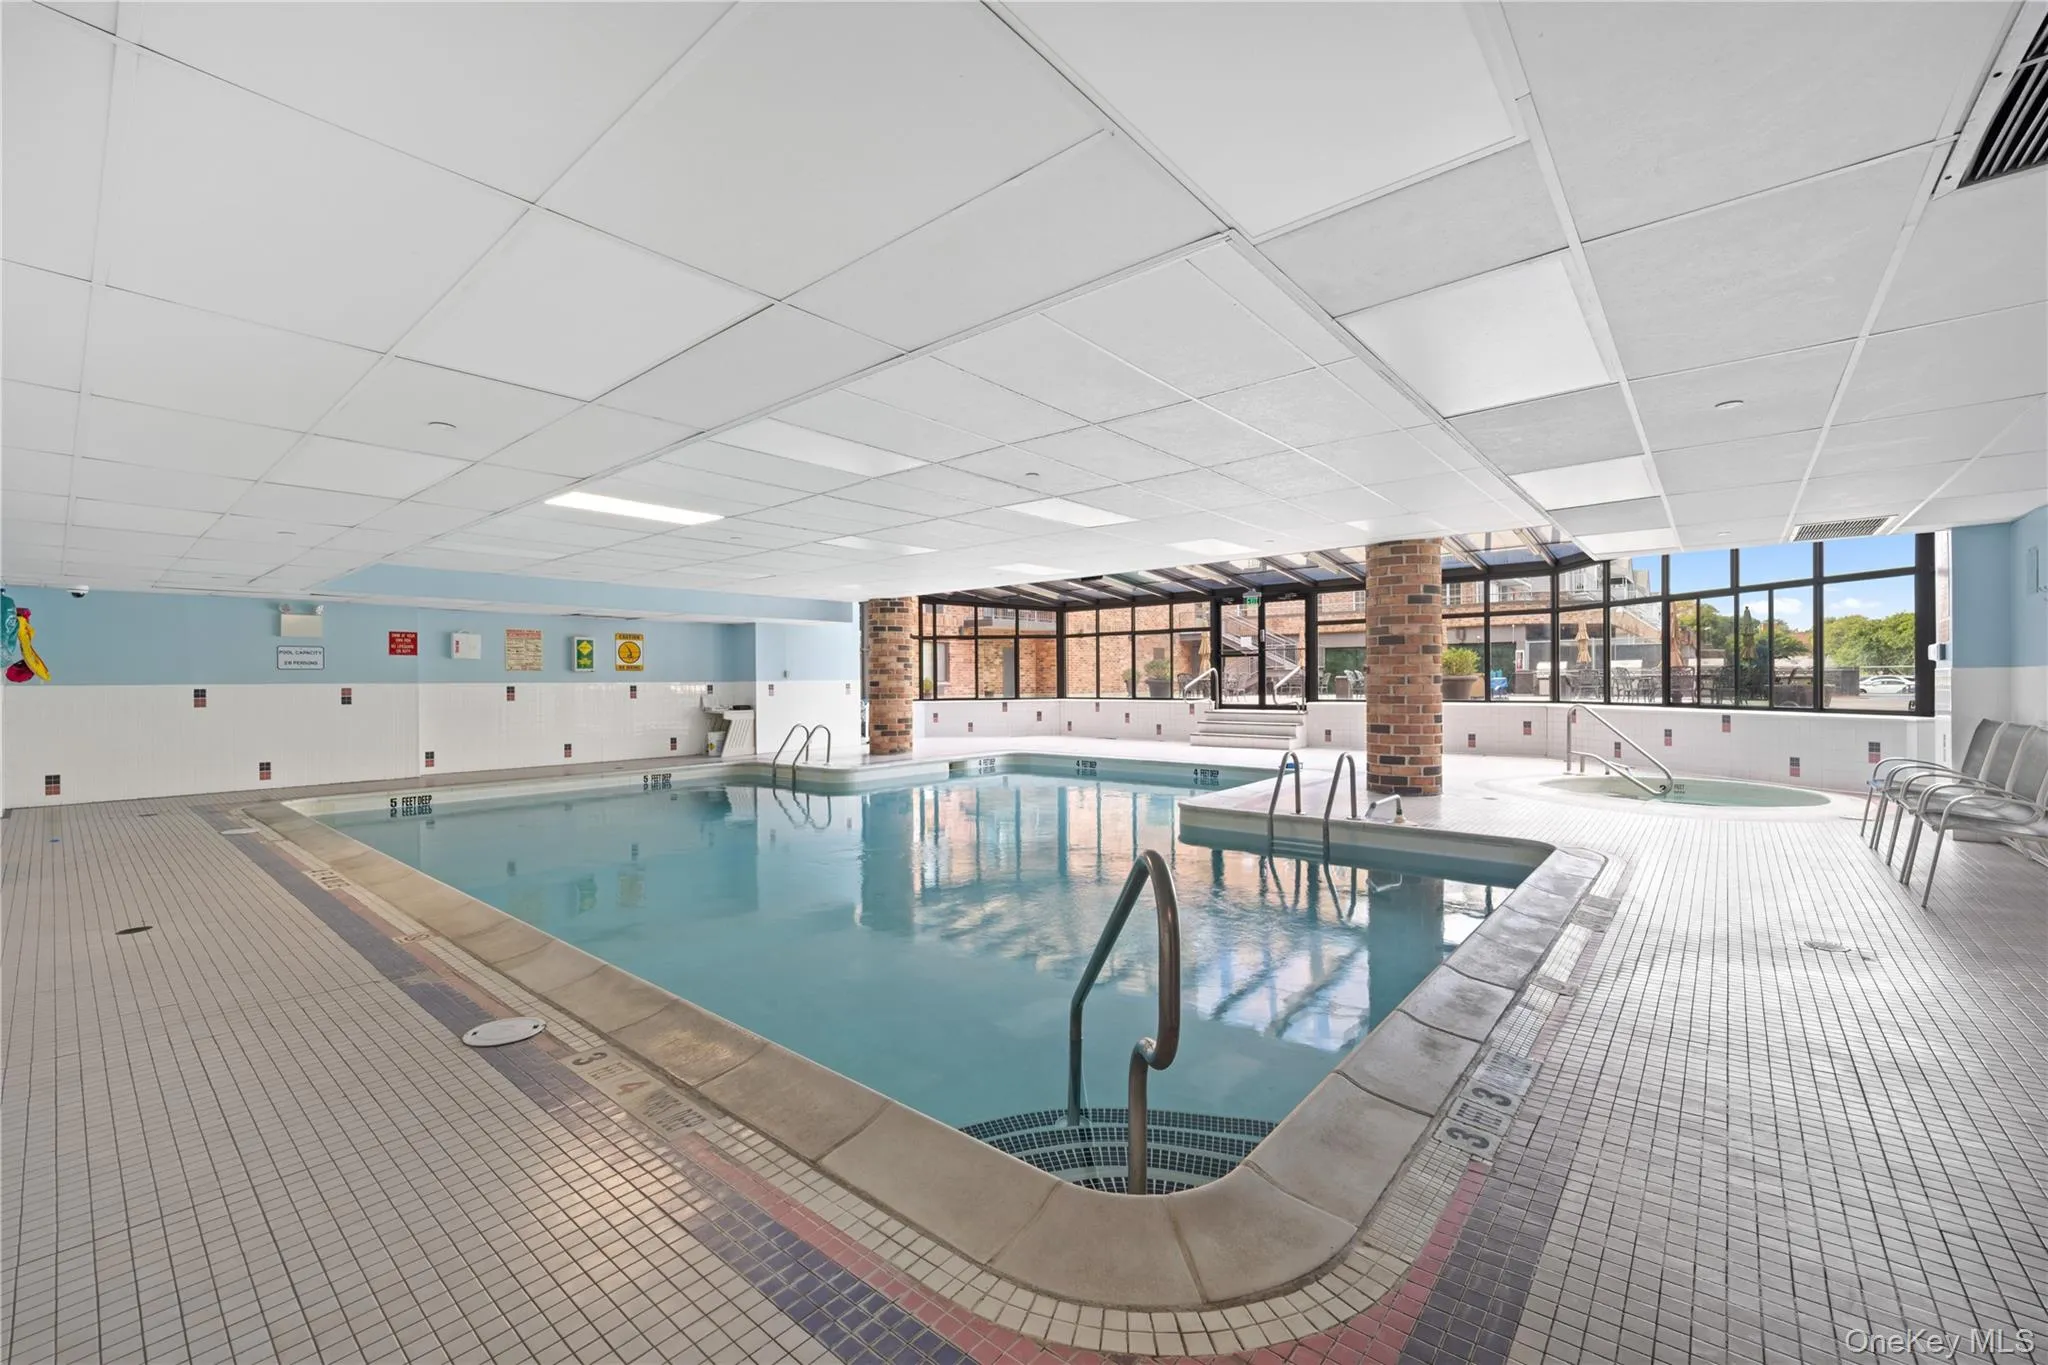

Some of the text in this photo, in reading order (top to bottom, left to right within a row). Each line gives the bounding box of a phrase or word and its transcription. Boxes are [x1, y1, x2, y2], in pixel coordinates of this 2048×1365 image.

[643, 775, 648, 783] 5
[651, 774, 661, 783] FEET
[1193, 768, 1219, 778] 4 FEET DEEP
[390, 794, 432, 808] 5 FEET DEEP
[572, 1052, 608, 1066] 3
[1446, 1127, 1490, 1149] 3
[1471, 1087, 1512, 1107] 3
